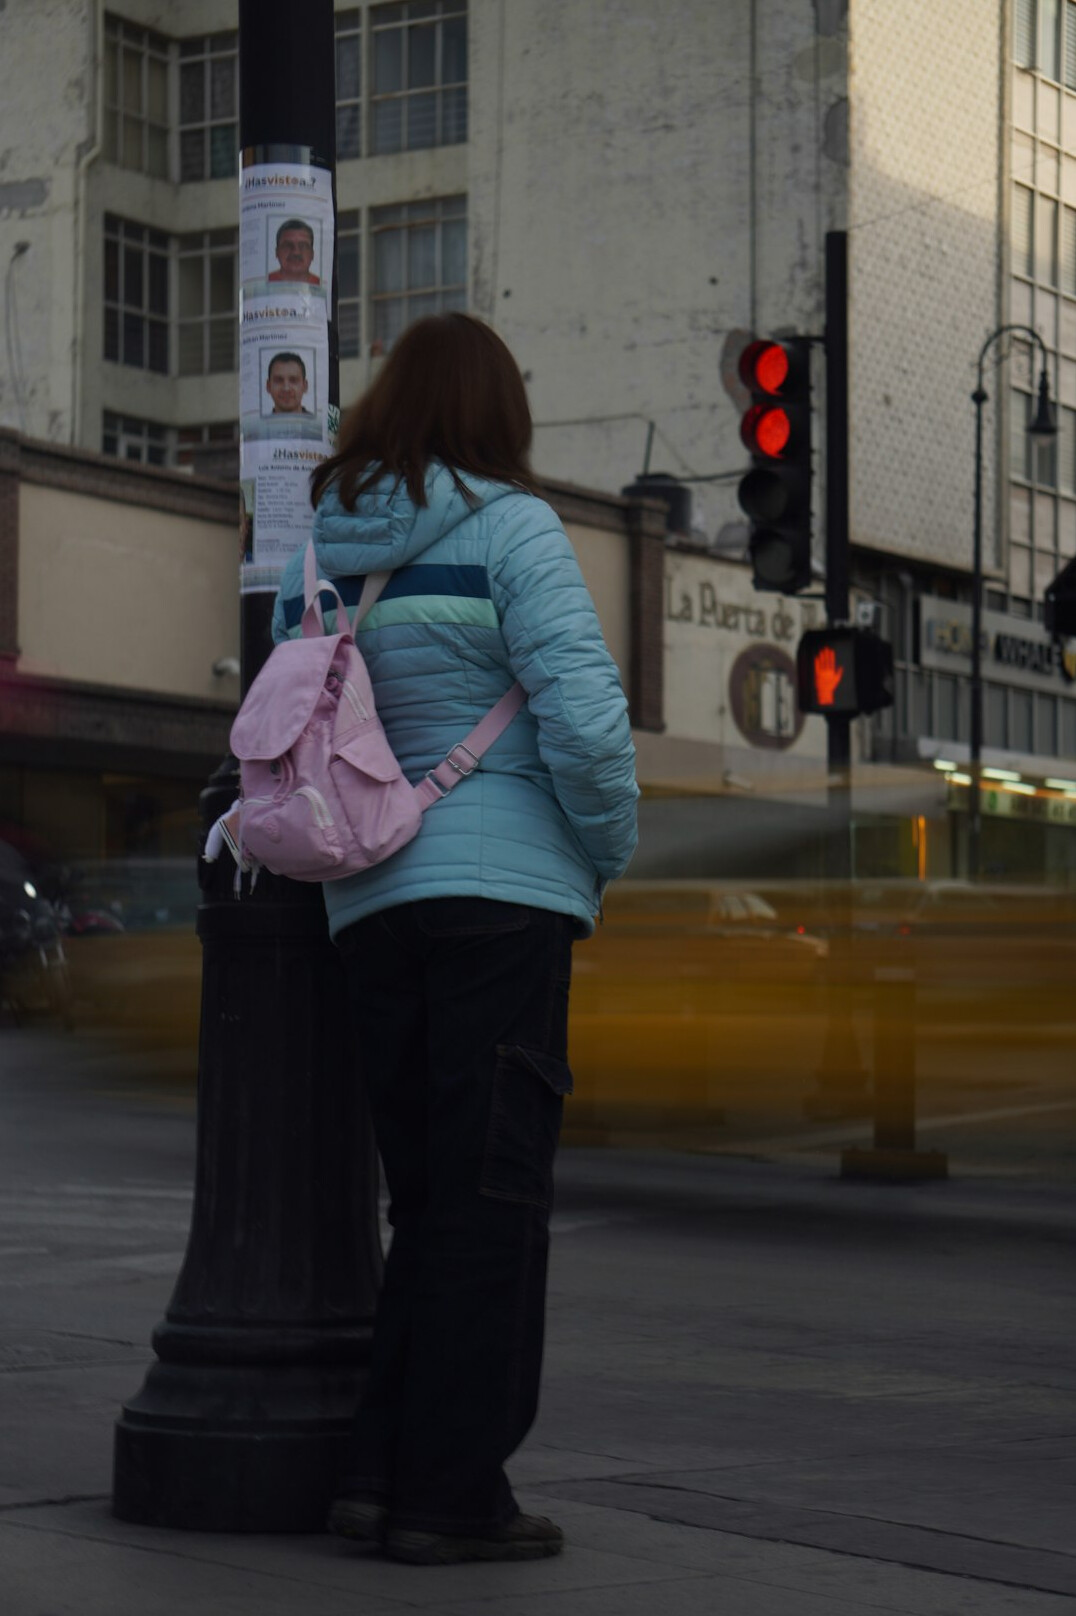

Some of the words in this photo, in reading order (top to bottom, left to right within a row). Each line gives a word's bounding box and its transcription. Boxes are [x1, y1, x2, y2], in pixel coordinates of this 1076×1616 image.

[666, 577, 692, 622] La
[699, 583, 765, 637] Puerta
[771, 599, 795, 641] de
